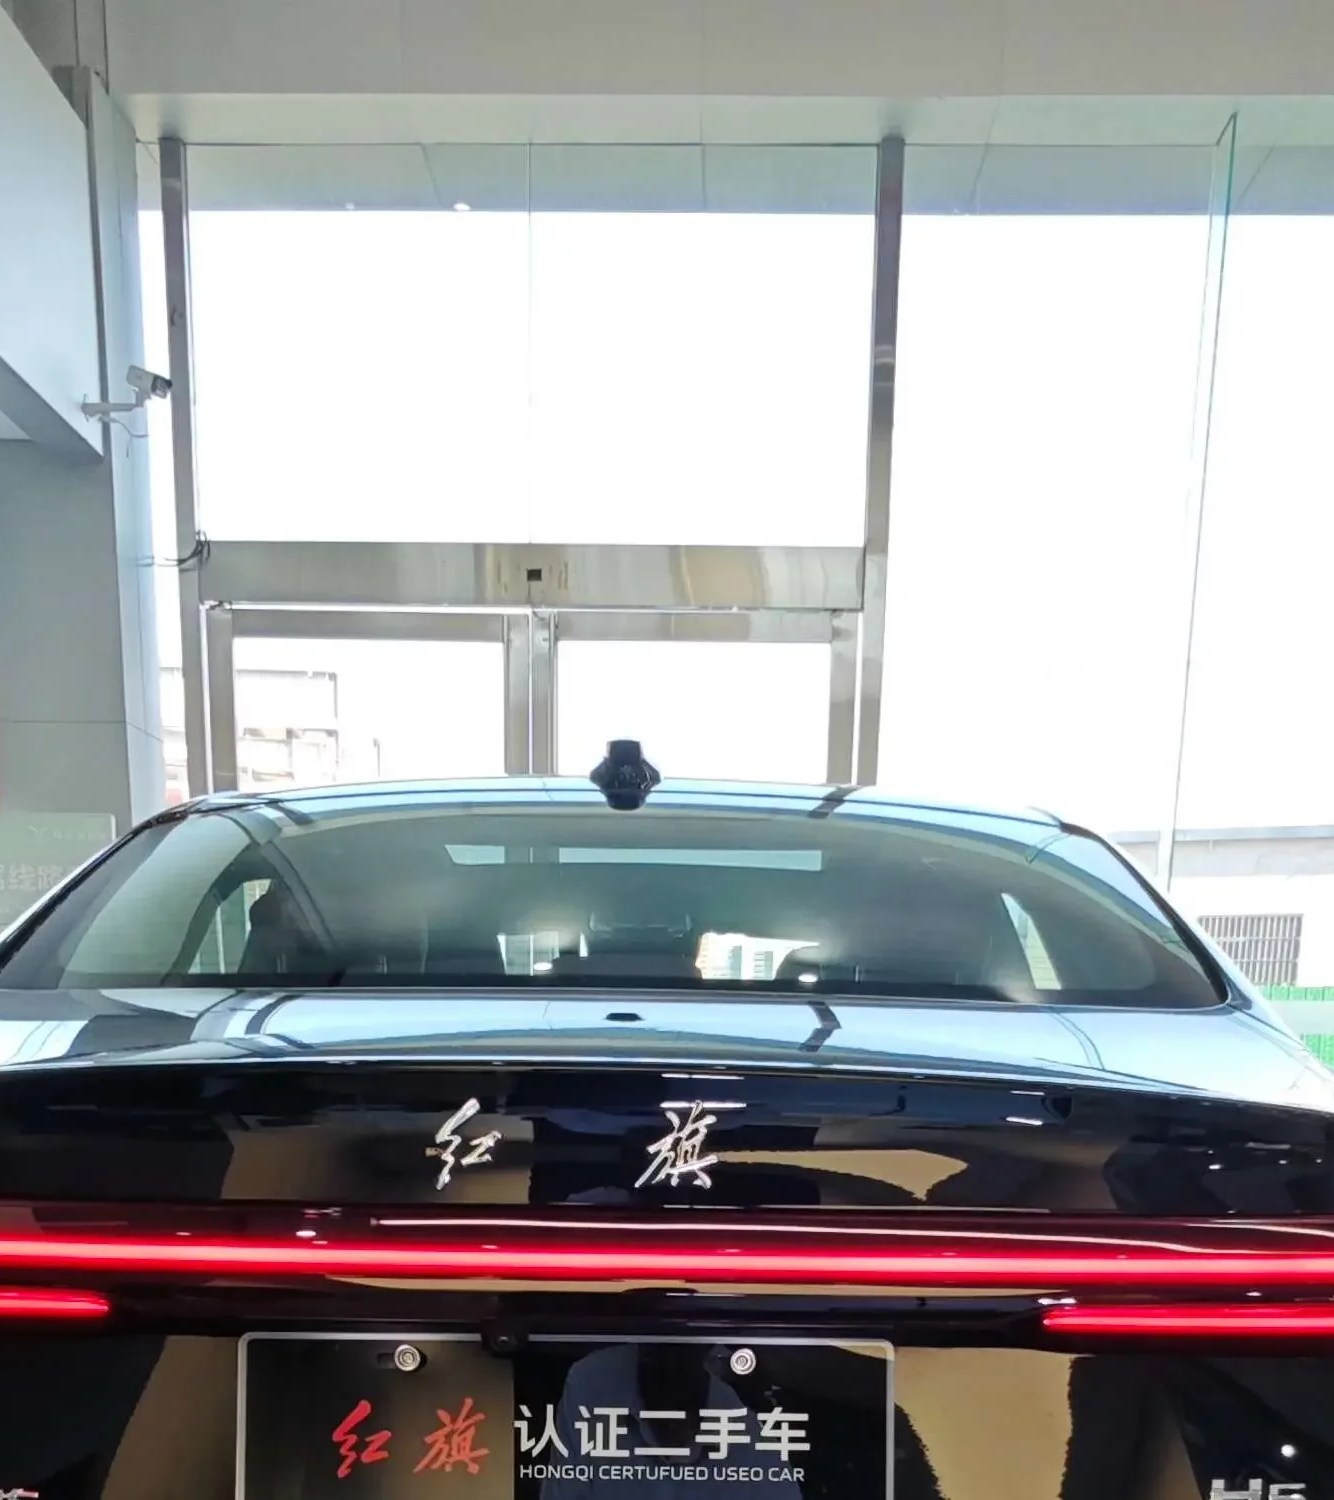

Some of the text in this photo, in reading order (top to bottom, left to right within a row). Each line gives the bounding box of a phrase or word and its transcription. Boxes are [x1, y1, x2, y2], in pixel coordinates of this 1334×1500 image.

[425, 1097, 719, 1189] 红旗
[332, 1397, 811, 1479] 红旗 认证二手车
[519, 1464, 805, 1482] HONGQI CERTUFUED USEO CAR
